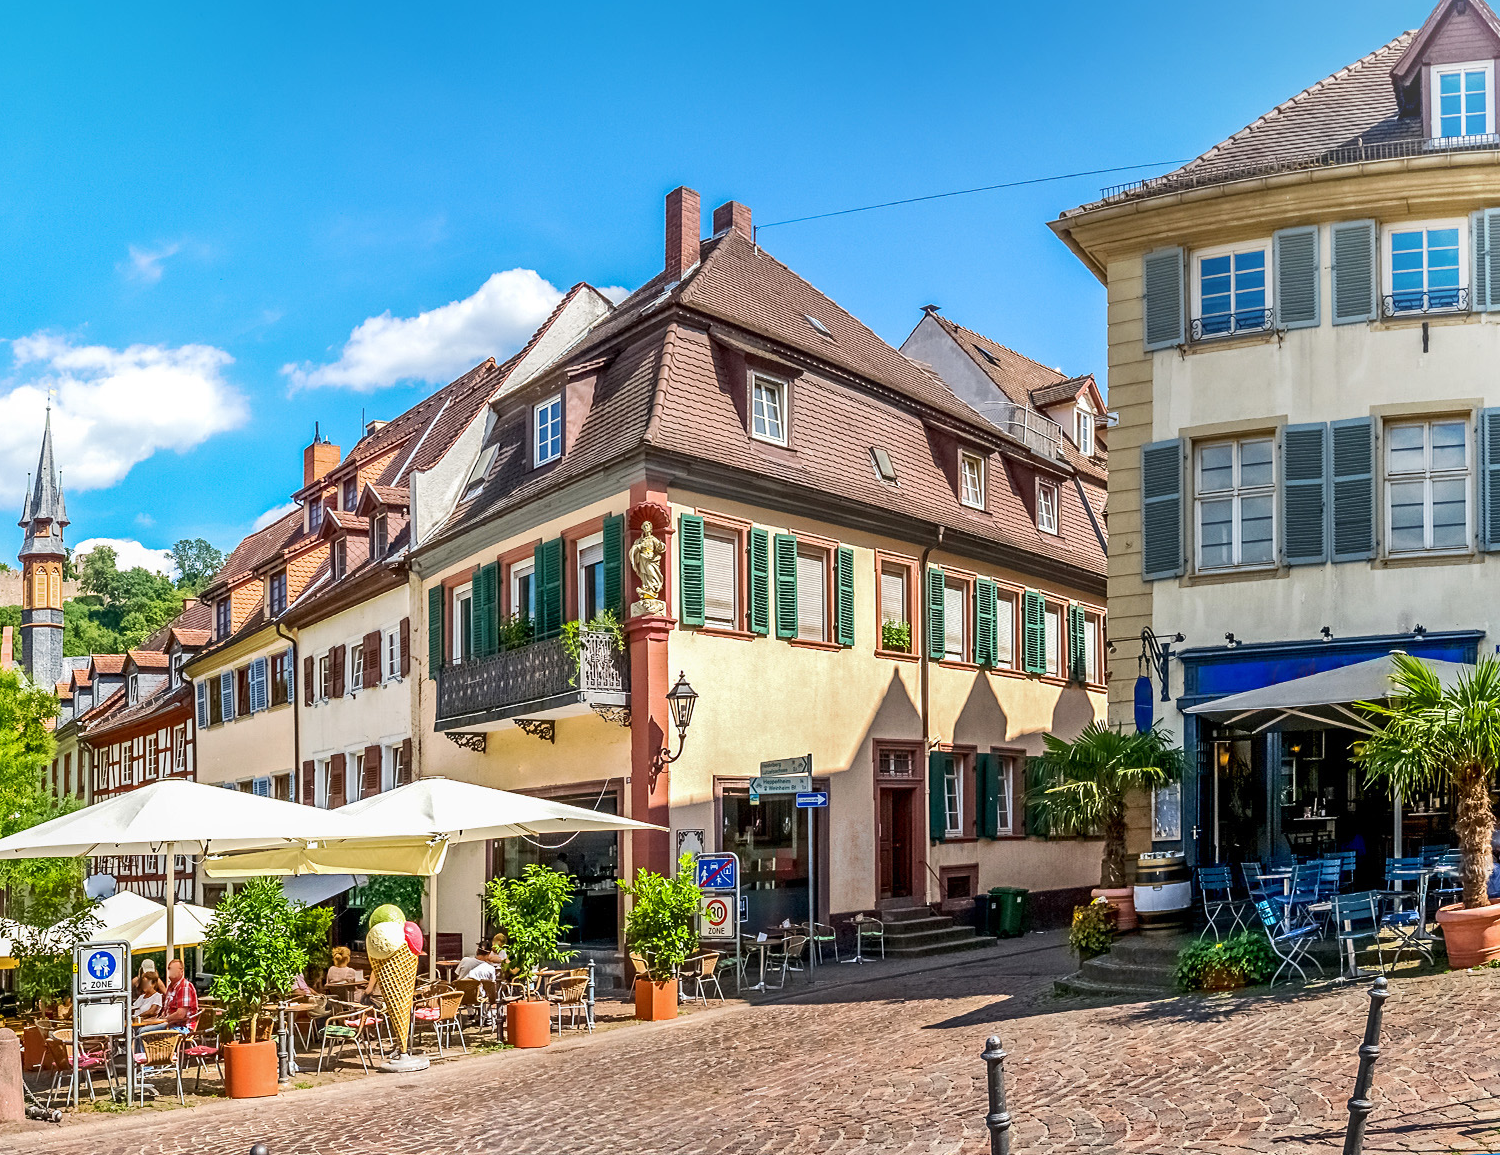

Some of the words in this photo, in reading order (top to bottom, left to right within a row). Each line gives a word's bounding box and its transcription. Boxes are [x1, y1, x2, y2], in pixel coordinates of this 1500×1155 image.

[710, 906, 723, 919] 30
[708, 927, 725, 935] ZONE
[91, 980, 113, 989] ZONE
